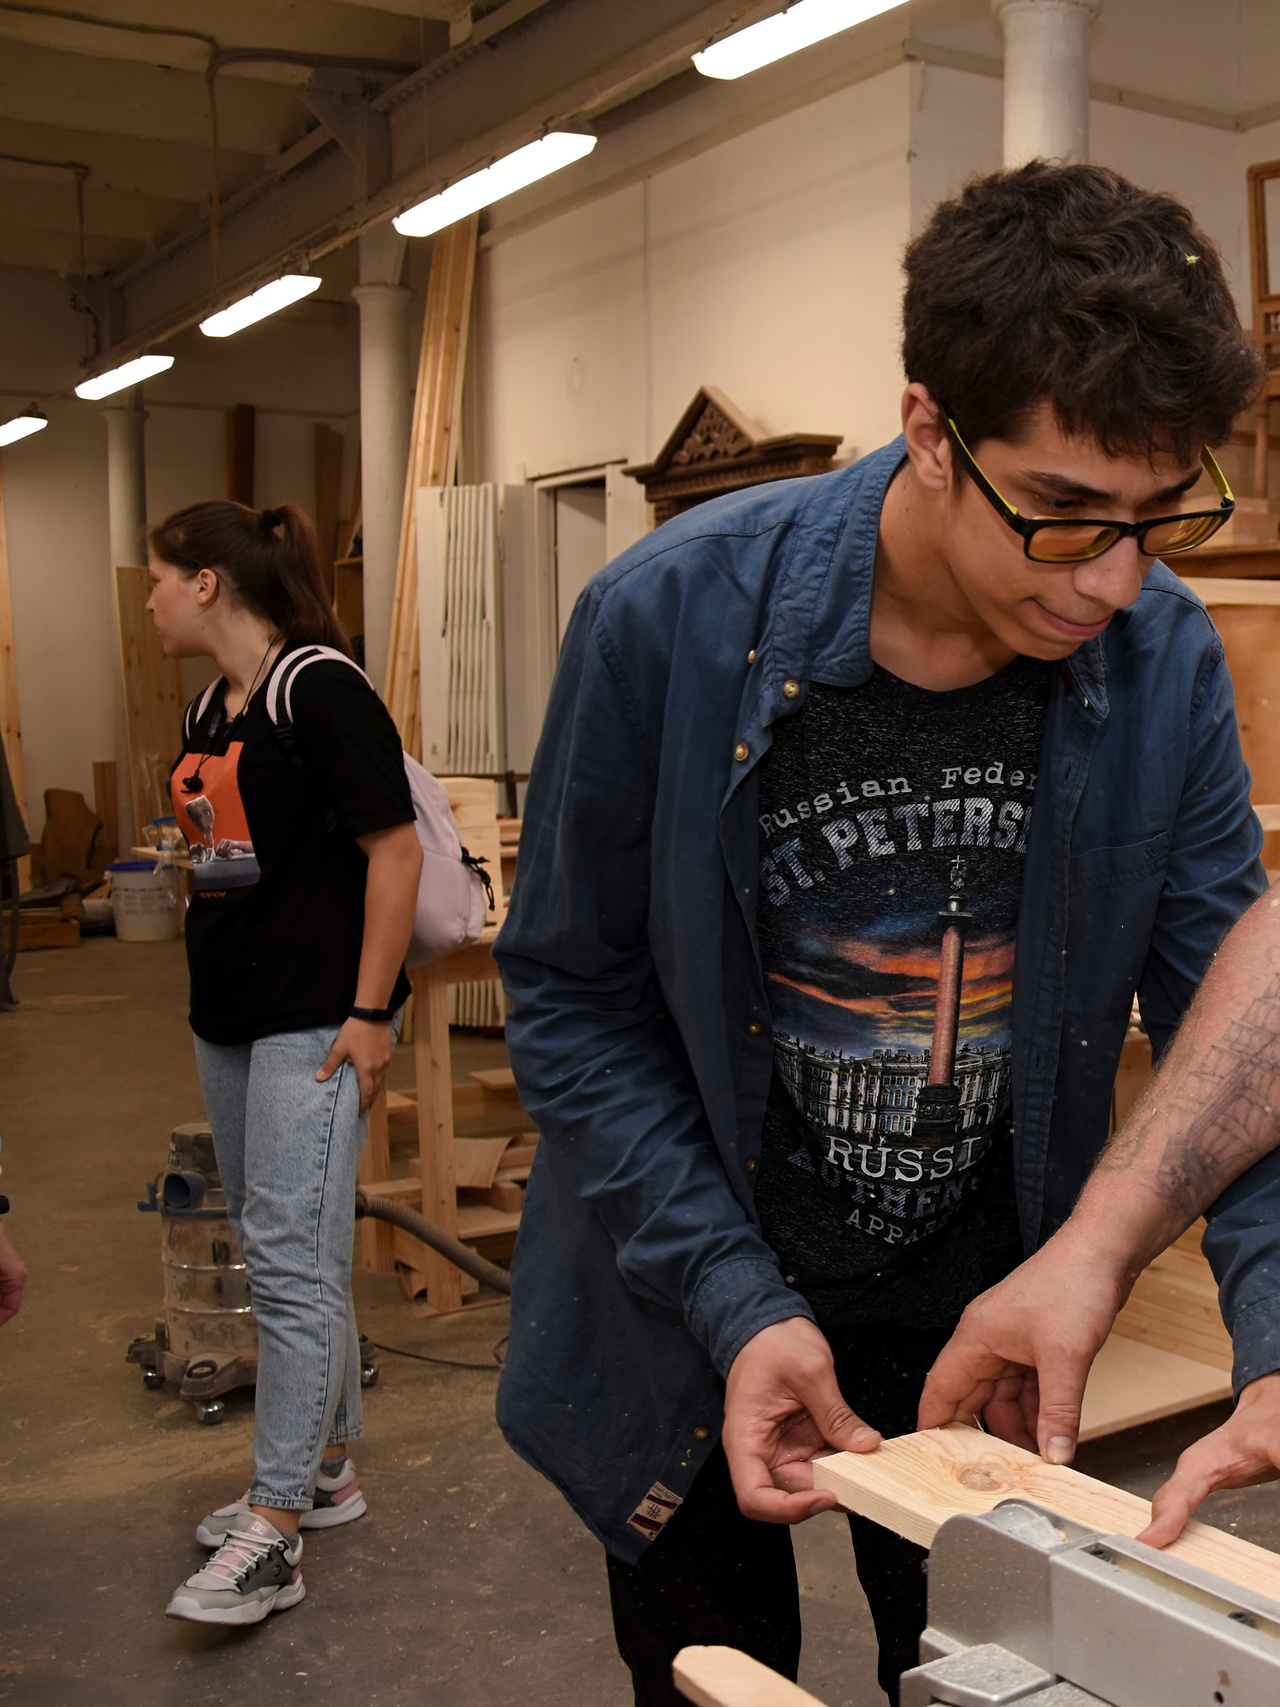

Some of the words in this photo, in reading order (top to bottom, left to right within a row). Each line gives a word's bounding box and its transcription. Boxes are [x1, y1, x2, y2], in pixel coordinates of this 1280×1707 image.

[759, 775, 912, 838] Russian
[760, 837, 826, 907] ST.
[786, 1150, 978, 1219] AUTHEN
